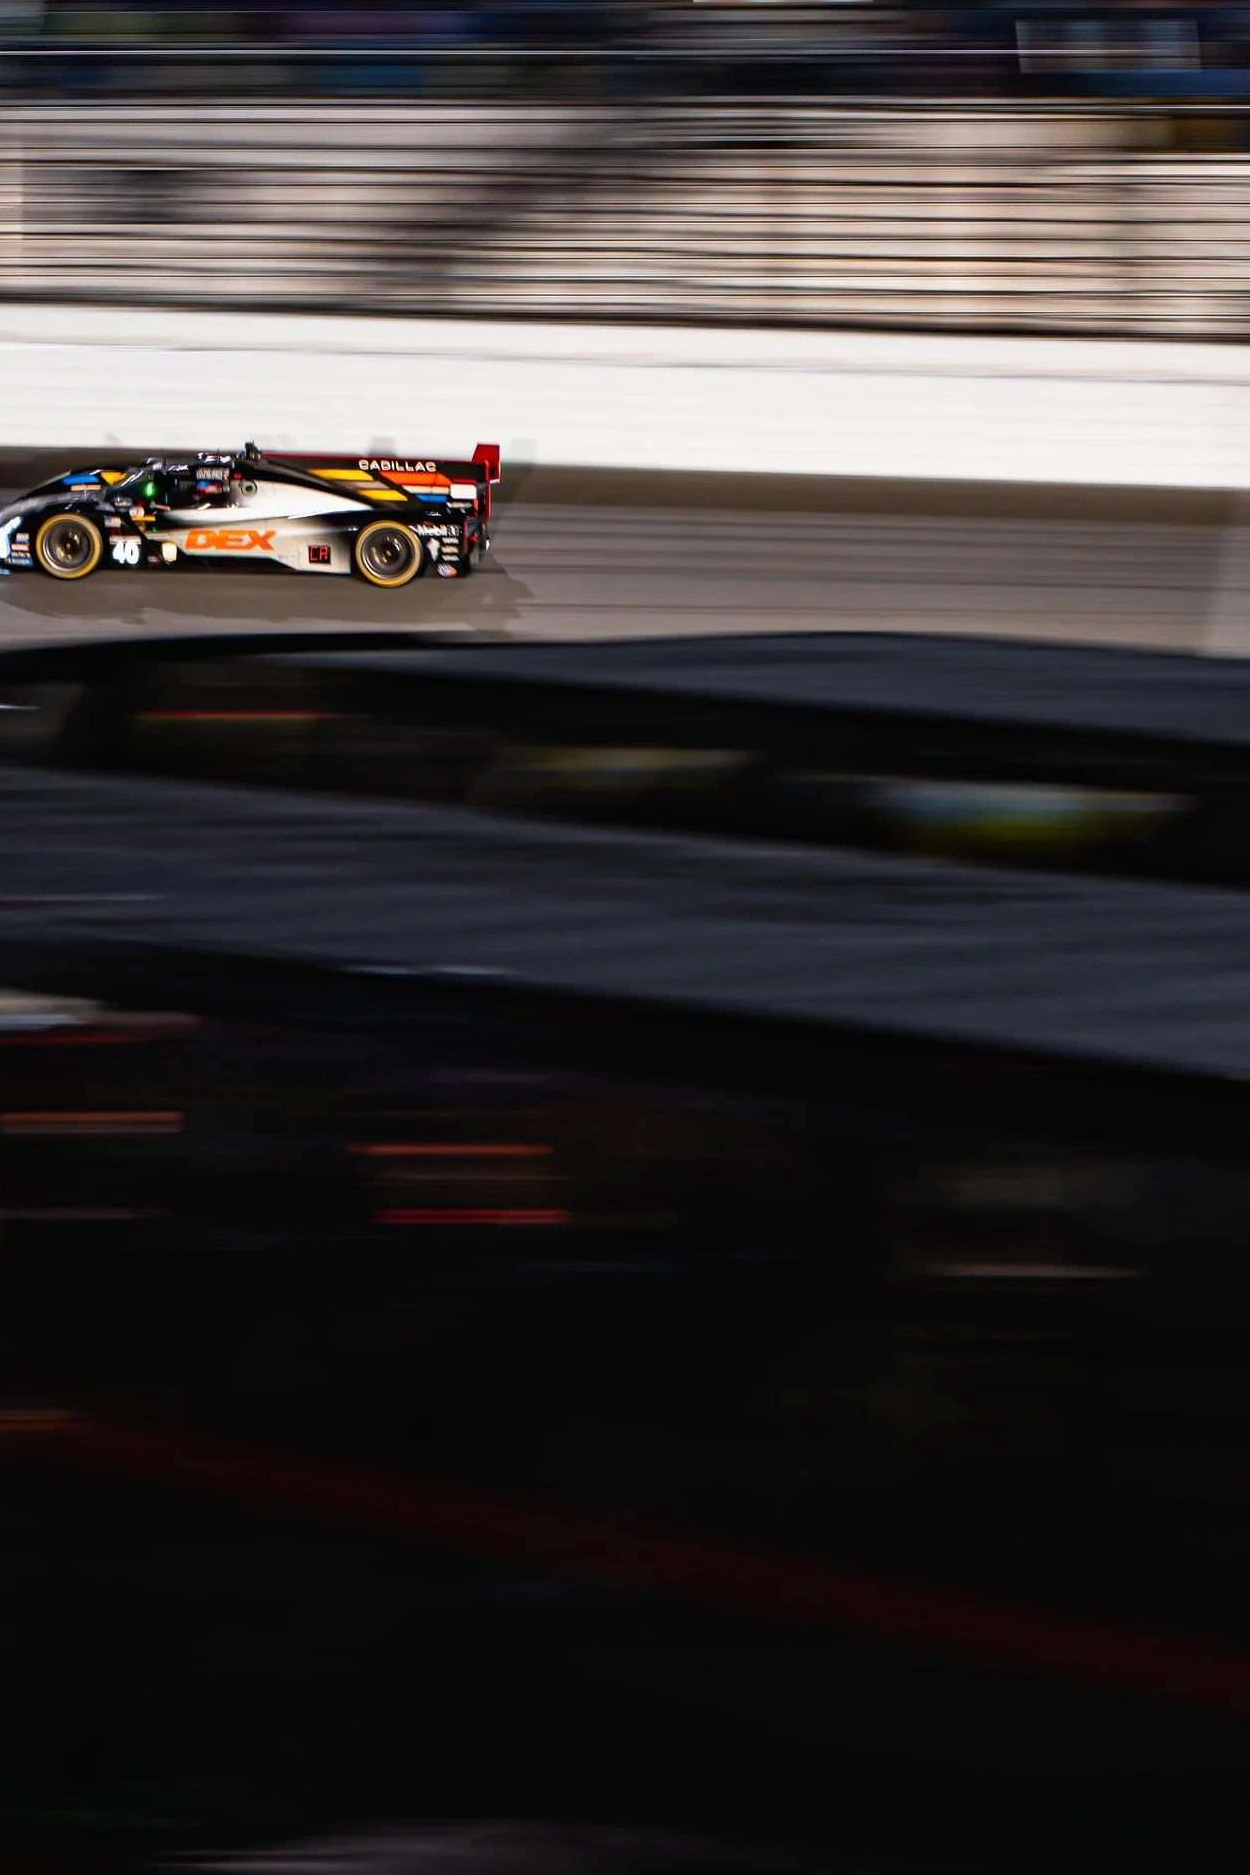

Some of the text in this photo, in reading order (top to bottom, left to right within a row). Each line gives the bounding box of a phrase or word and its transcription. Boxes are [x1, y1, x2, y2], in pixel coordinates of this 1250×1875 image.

[358, 459, 437, 472] CADILLAC
[185, 529, 277, 550] DEX
[112, 539, 140, 565] 40
